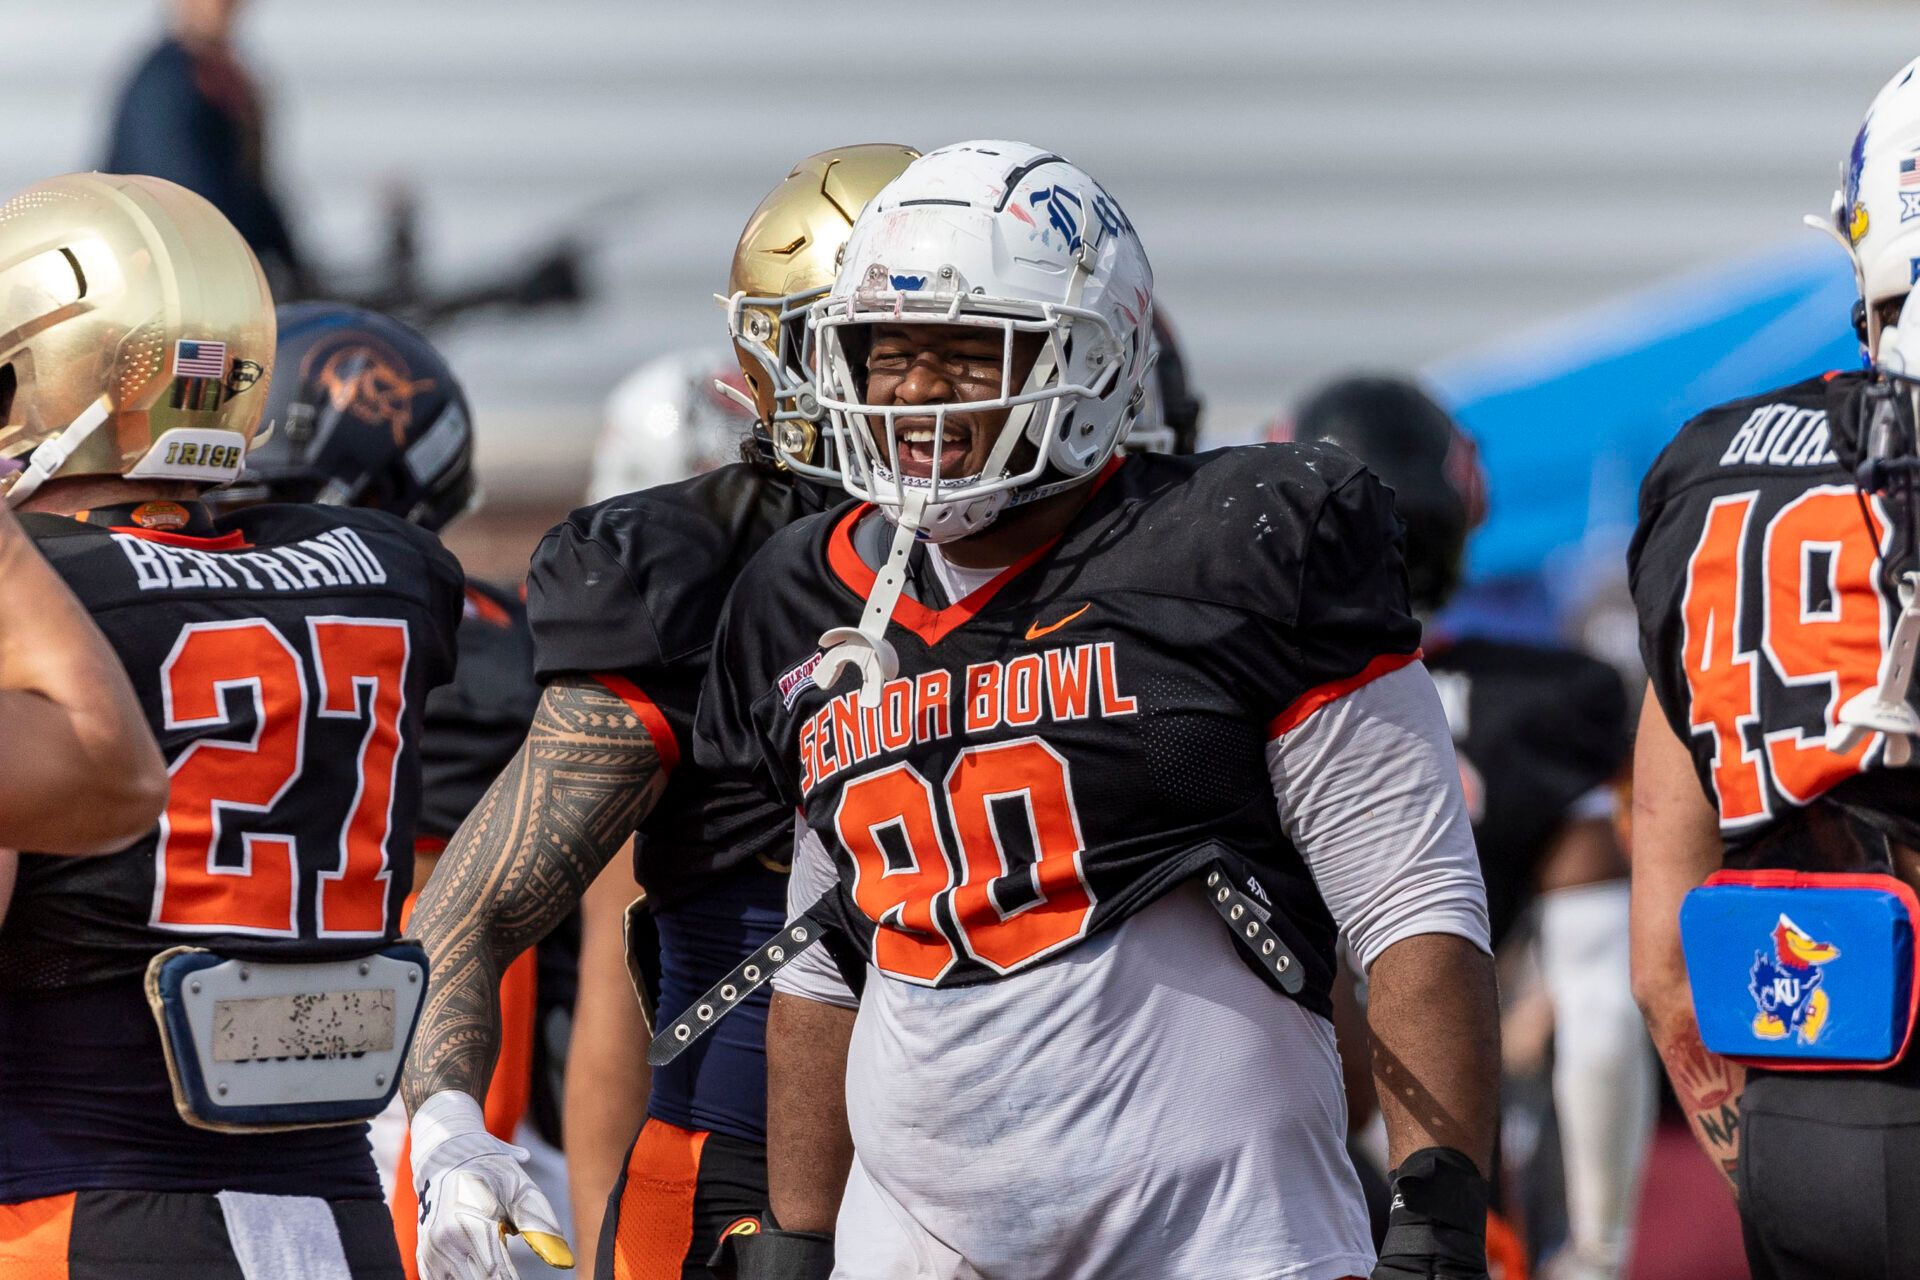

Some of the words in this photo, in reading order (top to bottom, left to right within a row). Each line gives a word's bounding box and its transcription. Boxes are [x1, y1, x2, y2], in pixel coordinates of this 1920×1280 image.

[165, 442, 241, 468] IRISH
[110, 527, 386, 591] BERTRAND
[800, 668, 951, 798] SENIOR
[965, 641, 1137, 732] BOWL
[1682, 485, 1893, 828] 49
[149, 615, 411, 938] 27
[834, 735, 1098, 987] 90
[1773, 977, 1800, 1007] KU
